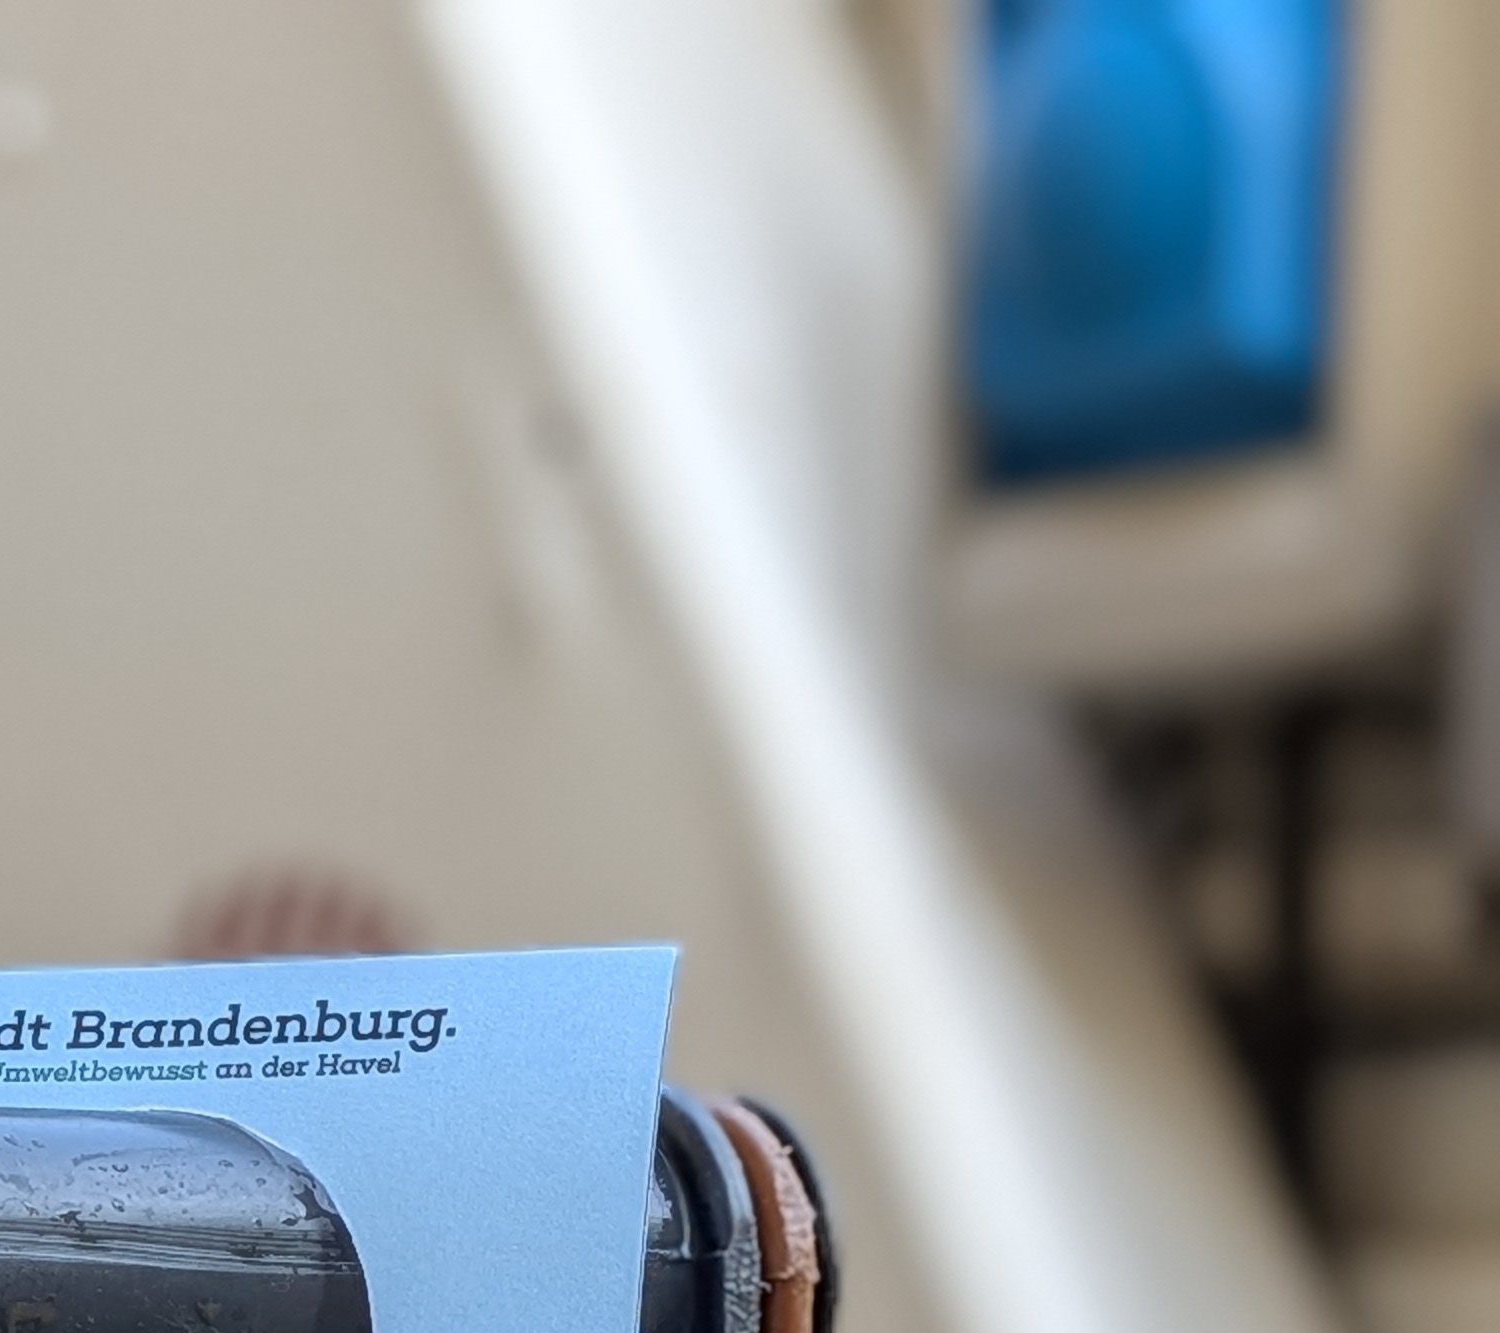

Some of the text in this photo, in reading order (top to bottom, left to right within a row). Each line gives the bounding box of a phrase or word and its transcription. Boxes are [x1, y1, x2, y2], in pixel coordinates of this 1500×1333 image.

[66, 1001, 457, 1052] Brandenburg.
[215, 1061, 252, 1079] an
[261, 1055, 310, 1078] der
[316, 1051, 401, 1076] Havel
